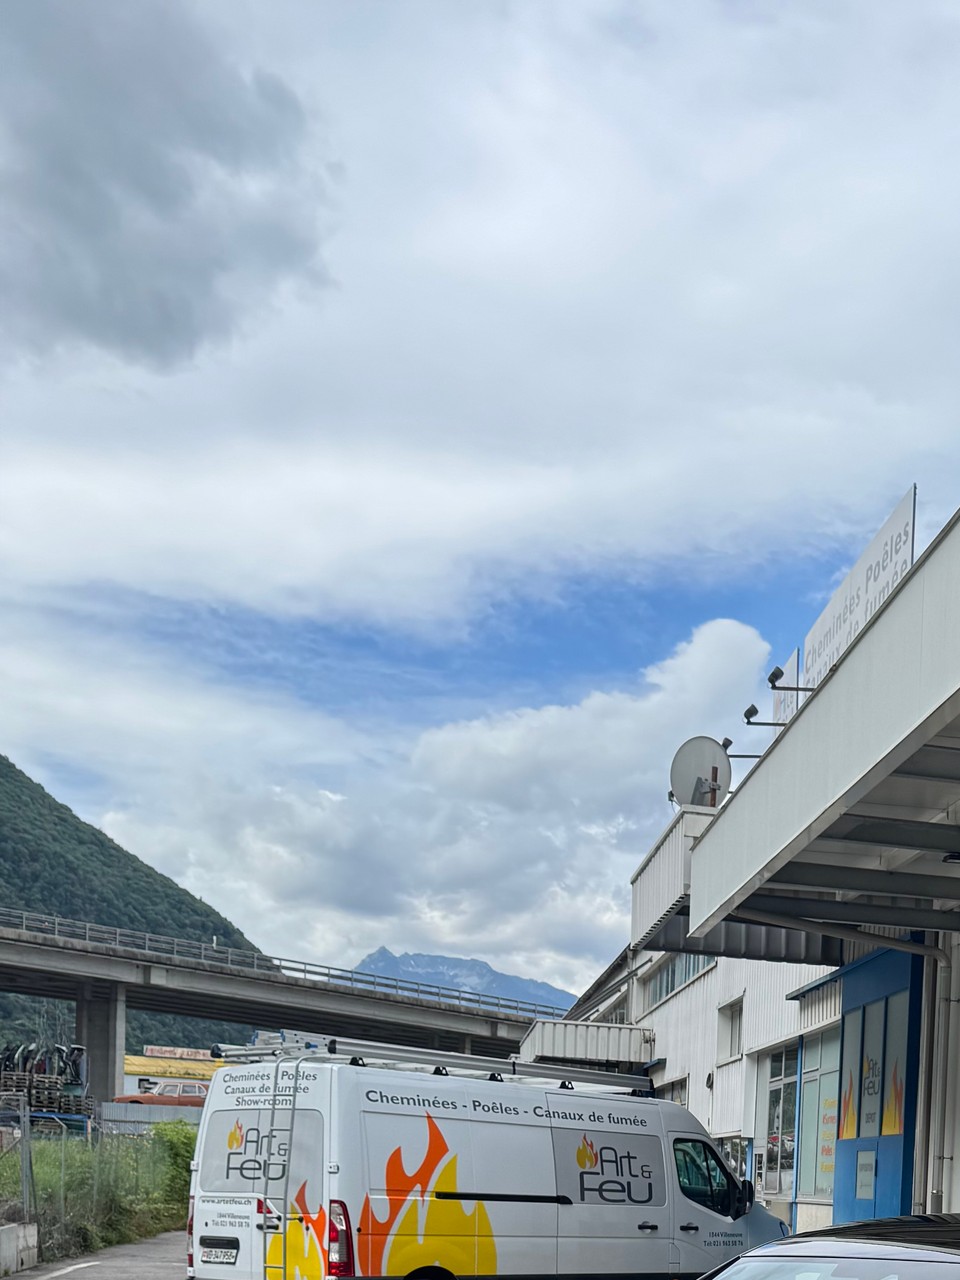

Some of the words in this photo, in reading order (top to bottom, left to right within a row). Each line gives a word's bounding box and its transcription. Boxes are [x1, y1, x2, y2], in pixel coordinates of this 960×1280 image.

[865, 521, 910, 594] Poêles
[223, 1071, 271, 1083] Cheminées
[224, 1085, 256, 1095] Canaux
[259, 1083, 271, 1094] de
[365, 1090, 458, 1110] Cheminées
[472, 1099, 520, 1116] Poêles
[533, 1106, 585, 1122] Canaux
[588, 1111, 604, 1124] de
[607, 1112, 648, 1128] fumée
[599, 1146, 638, 1179] Art
[579, 1171, 653, 1204] Feu
